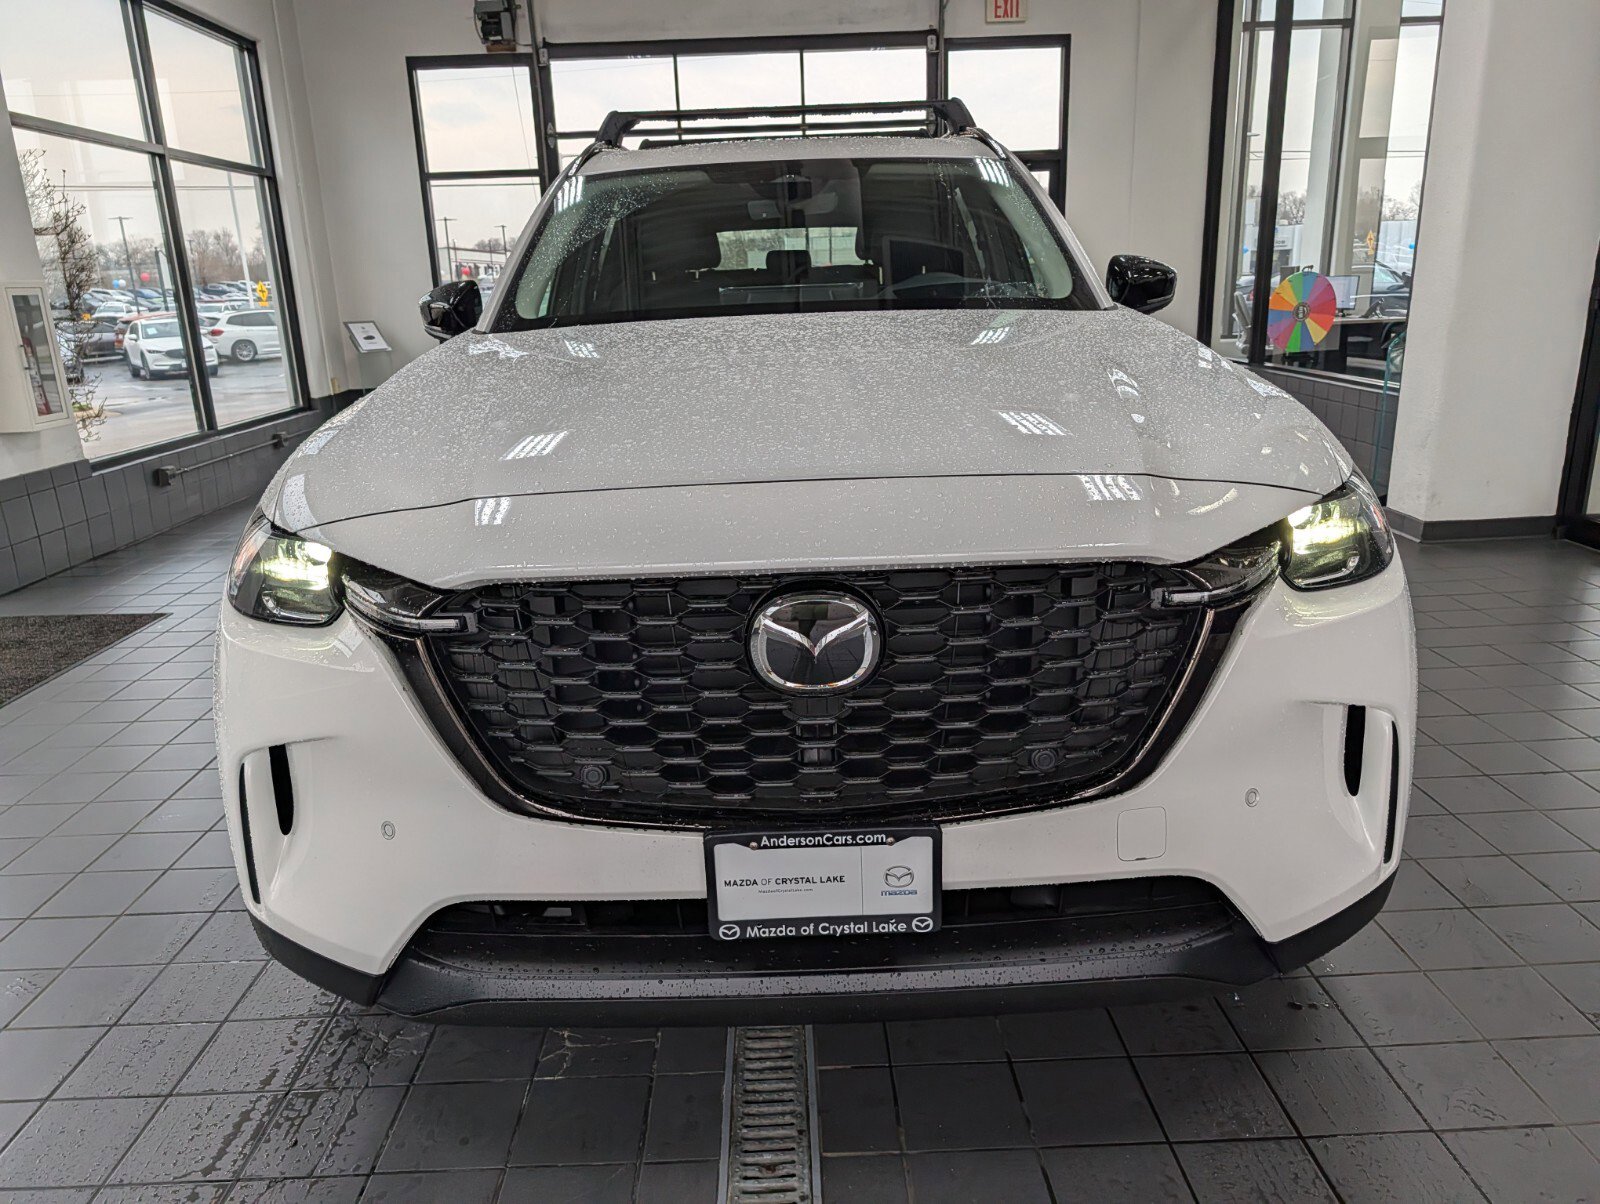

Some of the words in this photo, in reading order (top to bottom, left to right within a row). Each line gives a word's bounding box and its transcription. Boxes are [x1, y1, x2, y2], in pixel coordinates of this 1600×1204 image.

[994, 0, 1020, 18] EXIT
[760, 833, 886, 847] AndersonCars.com
[724, 879, 759, 887] MAZDA
[761, 878, 773, 886] OF
[775, 876, 817, 885] CRYSTAL
[819, 875, 846, 883] LAKE
[746, 924, 796, 938] Mazda
[801, 922, 815, 935] of
[818, 921, 868, 937] Crystal
[872, 919, 907, 933] Lake
